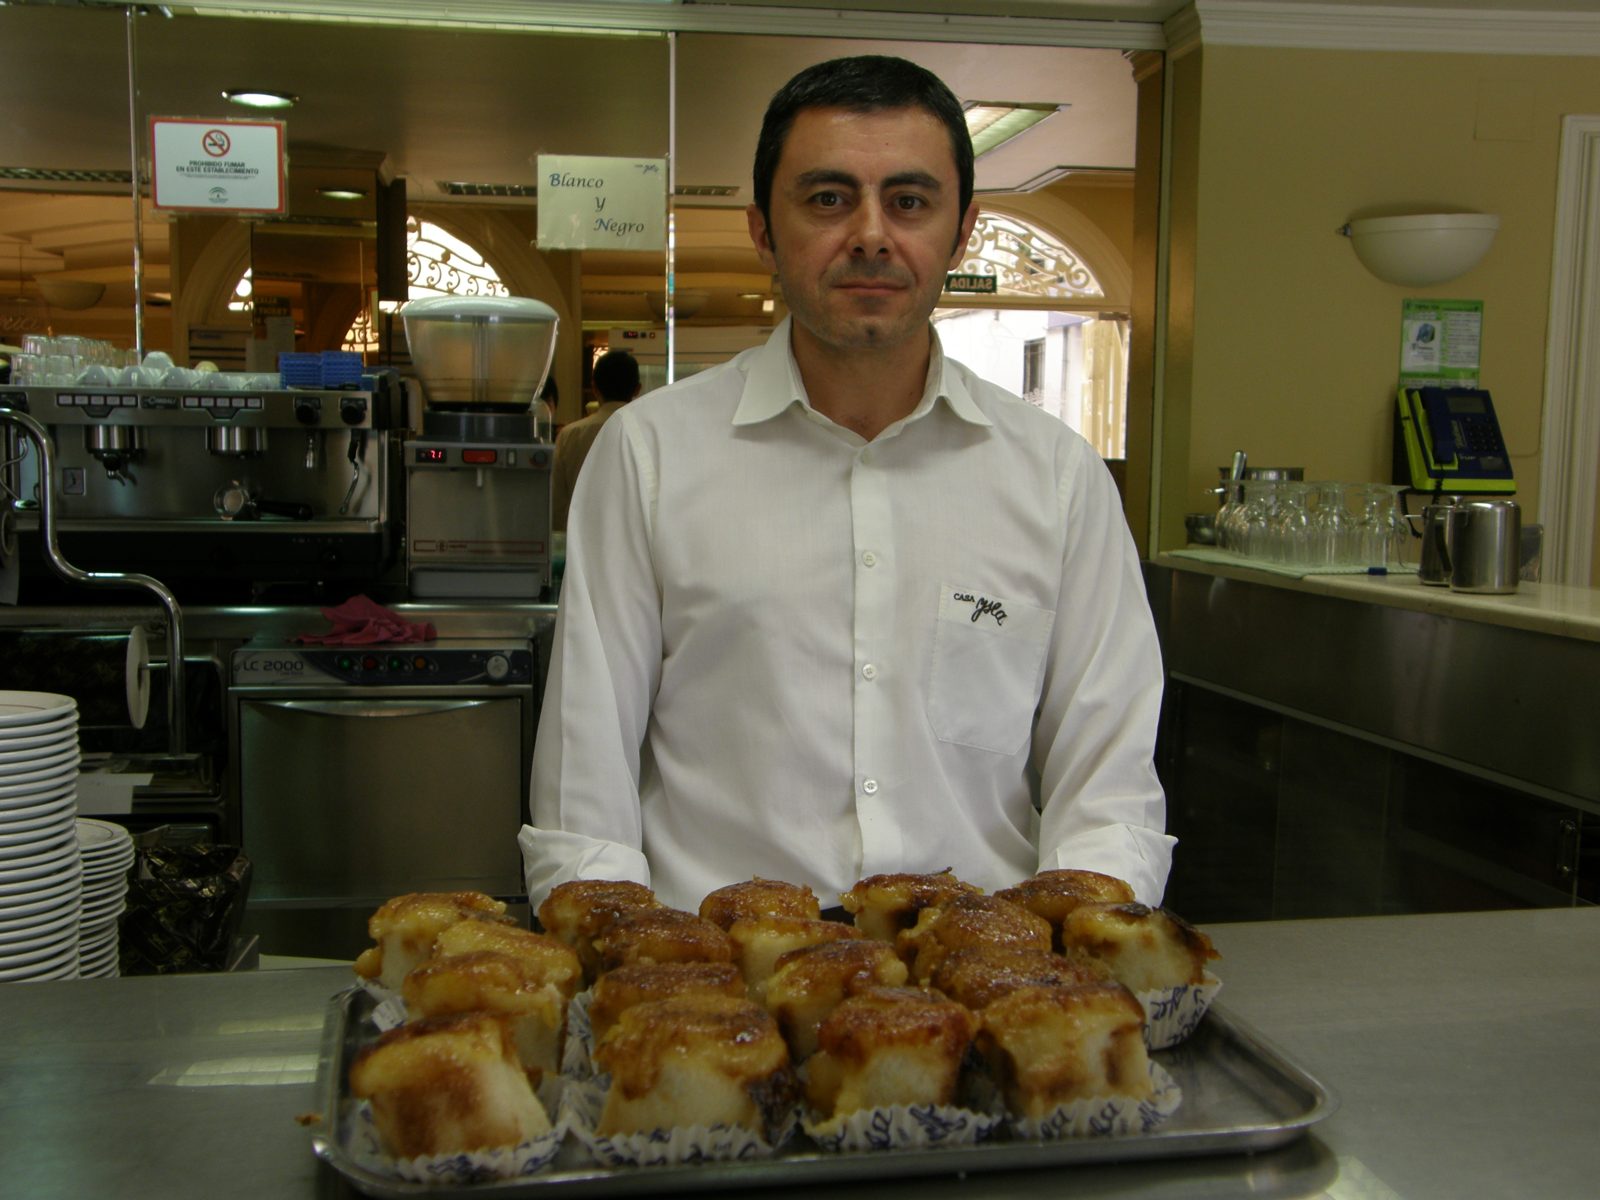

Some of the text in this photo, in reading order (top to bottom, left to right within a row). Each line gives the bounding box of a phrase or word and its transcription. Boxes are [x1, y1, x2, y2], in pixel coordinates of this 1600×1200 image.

[189, 160, 222, 168] PROHIBIDO
[203, 167, 259, 175] ESTABLECIMIENTO
[549, 173, 604, 188] Blanco
[593, 217, 645, 237] Negro
[243, 660, 304, 672] LC 2000
